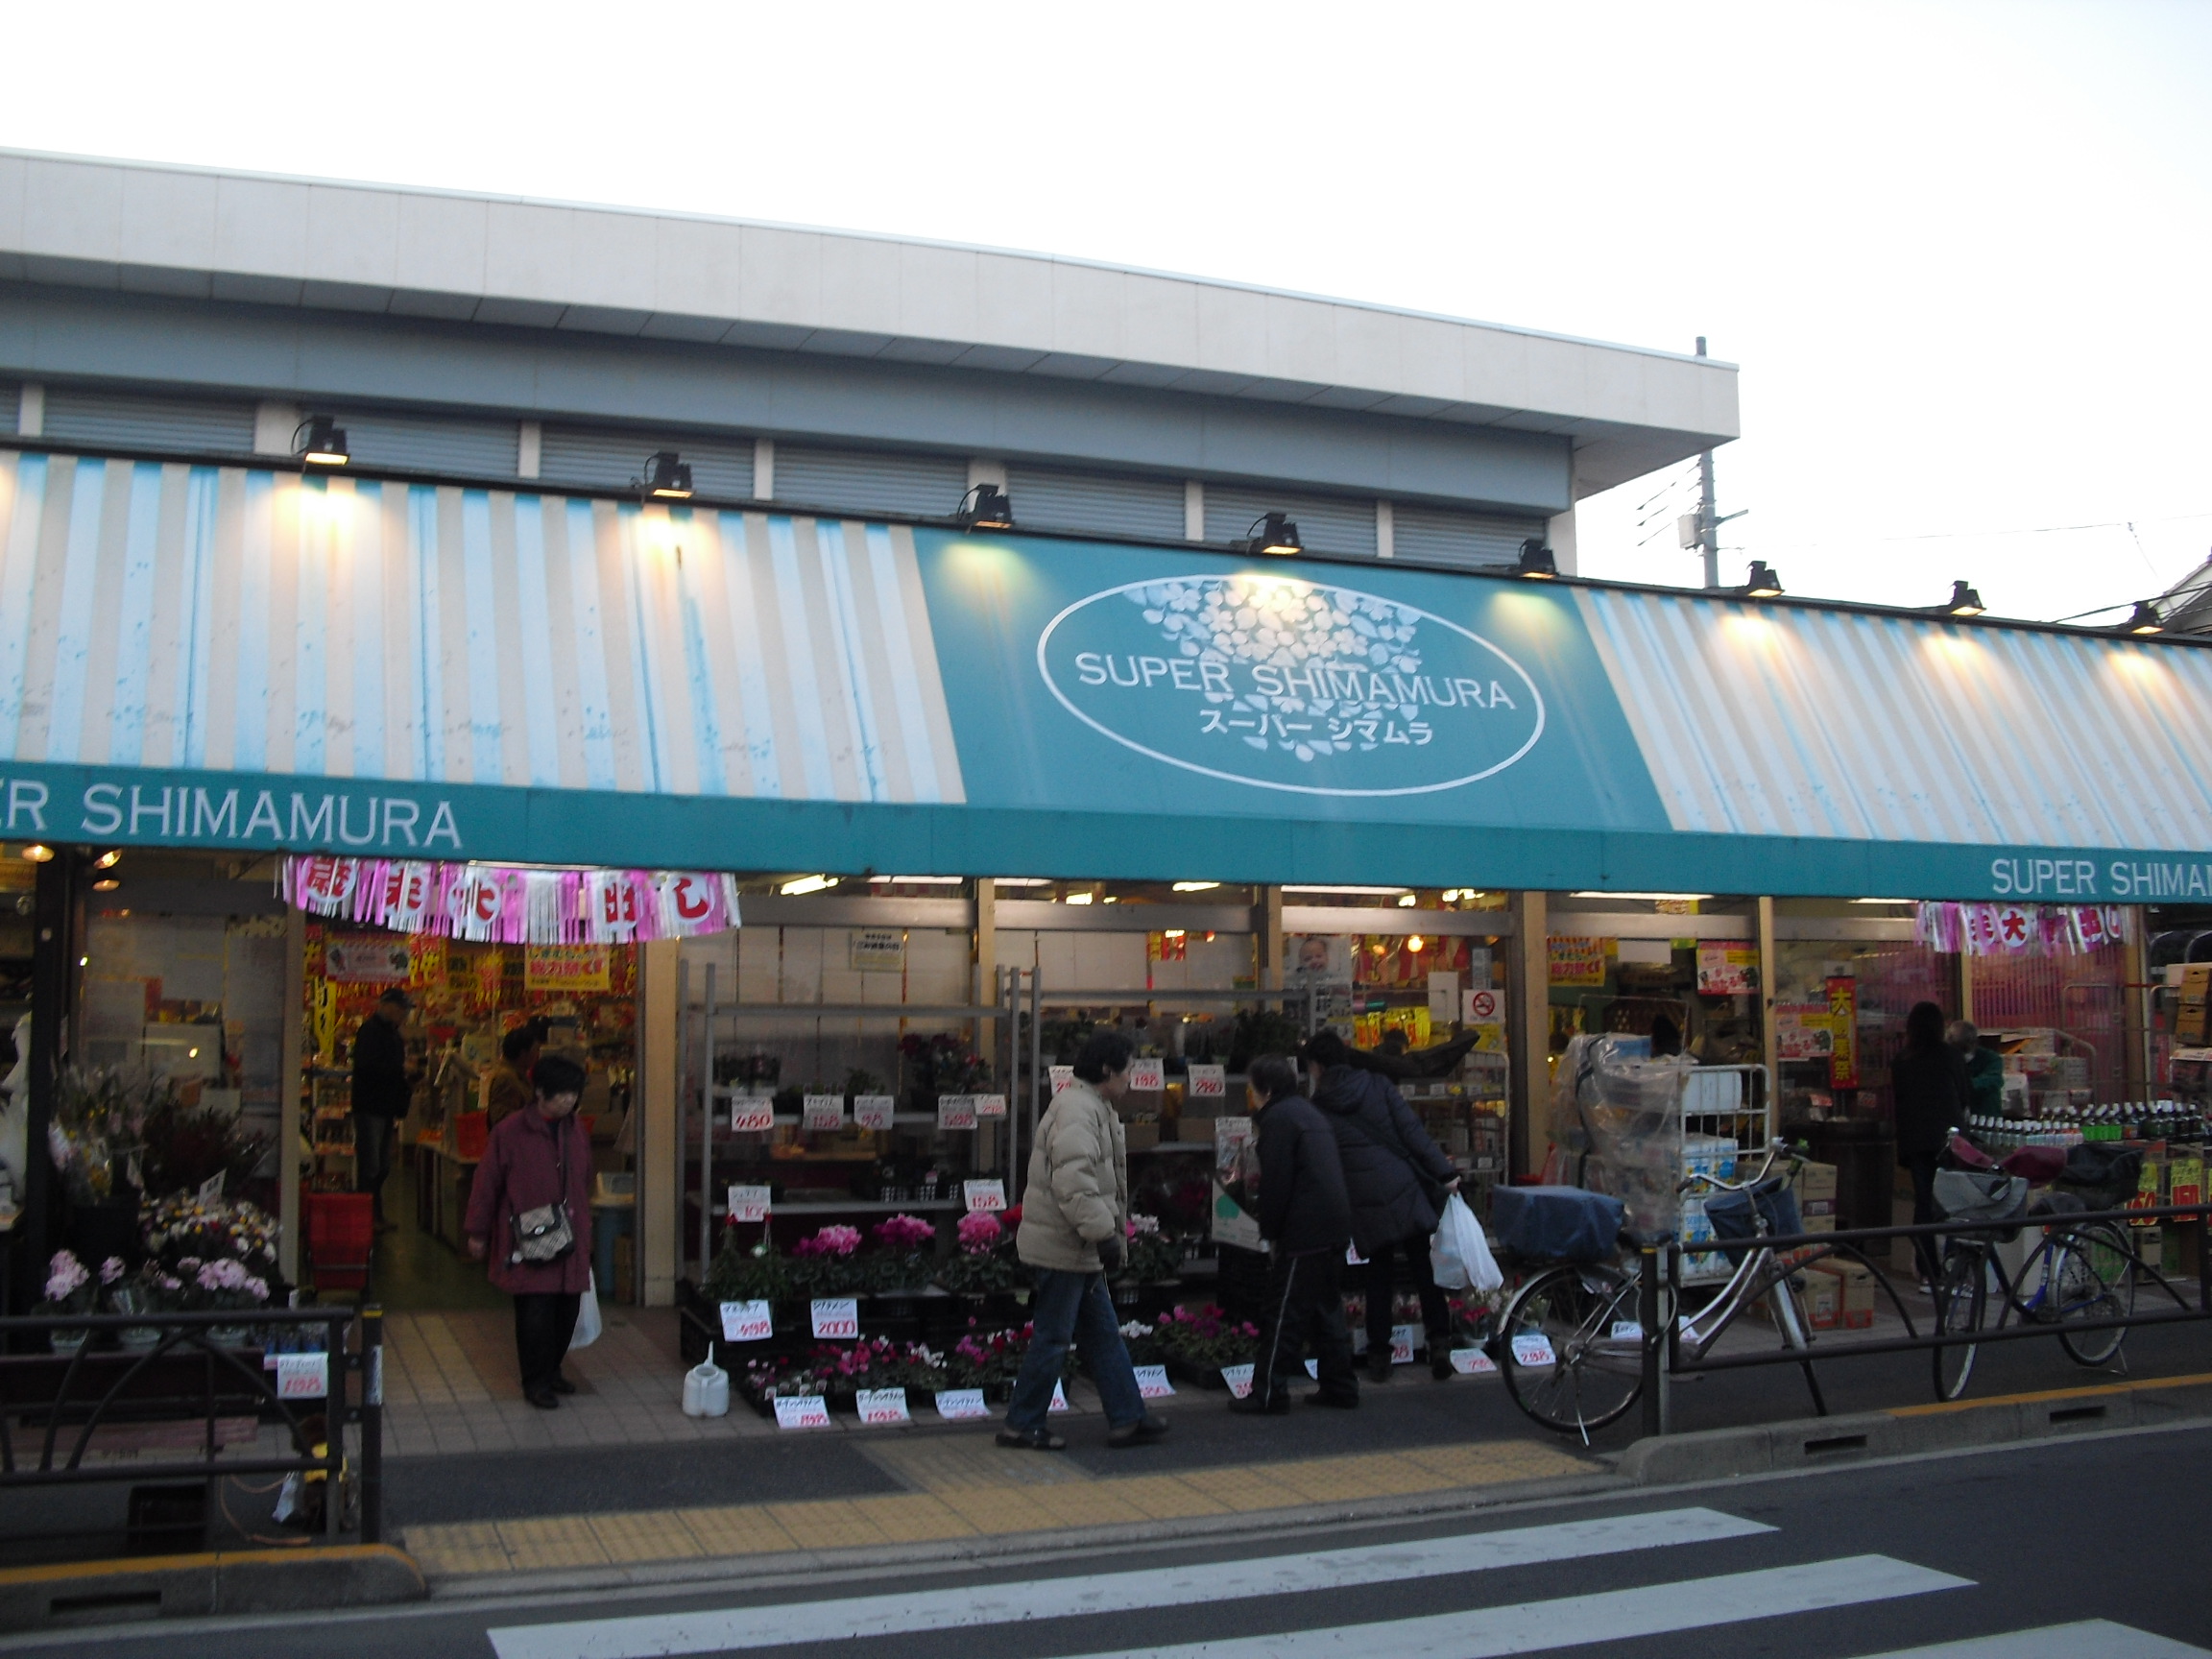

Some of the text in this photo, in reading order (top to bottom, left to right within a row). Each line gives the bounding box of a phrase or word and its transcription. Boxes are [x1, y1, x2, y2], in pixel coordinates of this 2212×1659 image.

[1074, 652, 1517, 710] SUPER SHIMAMURA
[1200, 709, 1433, 746] スーパー シマムラ
[0, 778, 463, 850] R SHIMAMURA
[1992, 858, 2212, 897] SUPER SHIMA
[819, 1320, 855, 1335] 2000
